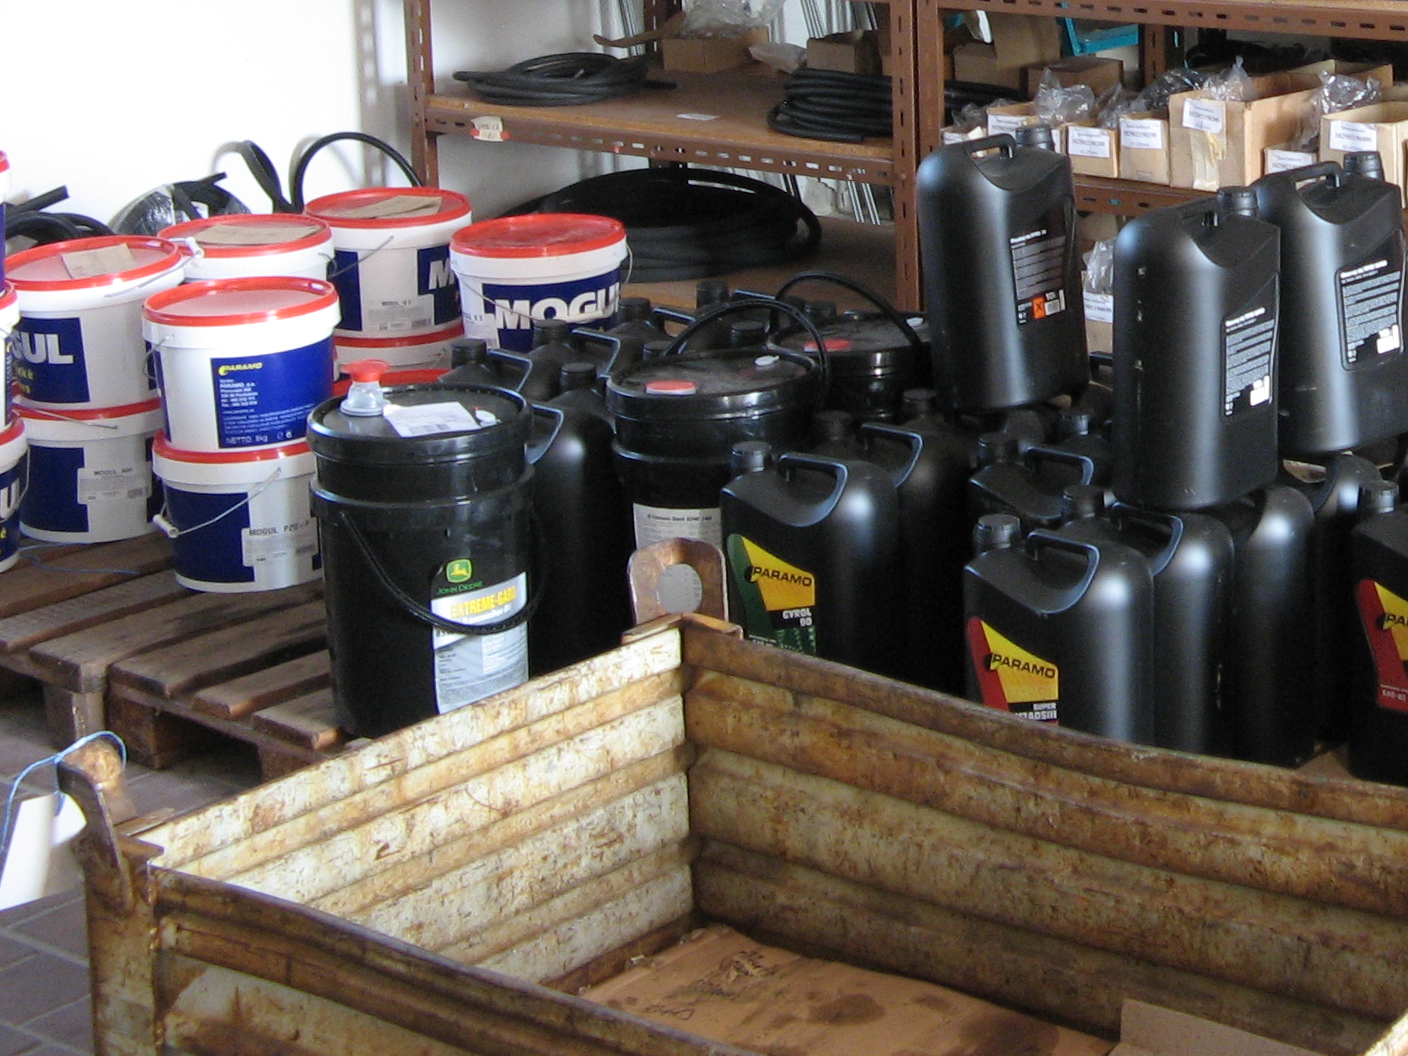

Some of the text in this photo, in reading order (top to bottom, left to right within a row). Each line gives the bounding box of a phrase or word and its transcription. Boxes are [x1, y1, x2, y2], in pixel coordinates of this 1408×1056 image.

[753, 566, 812, 587] PARAMO
[438, 581, 483, 595] JOHN DEERE
[451, 586, 517, 618] EXTREME-GARD
[782, 609, 812, 620] GYROL
[992, 653, 1056, 679] PARAMO
